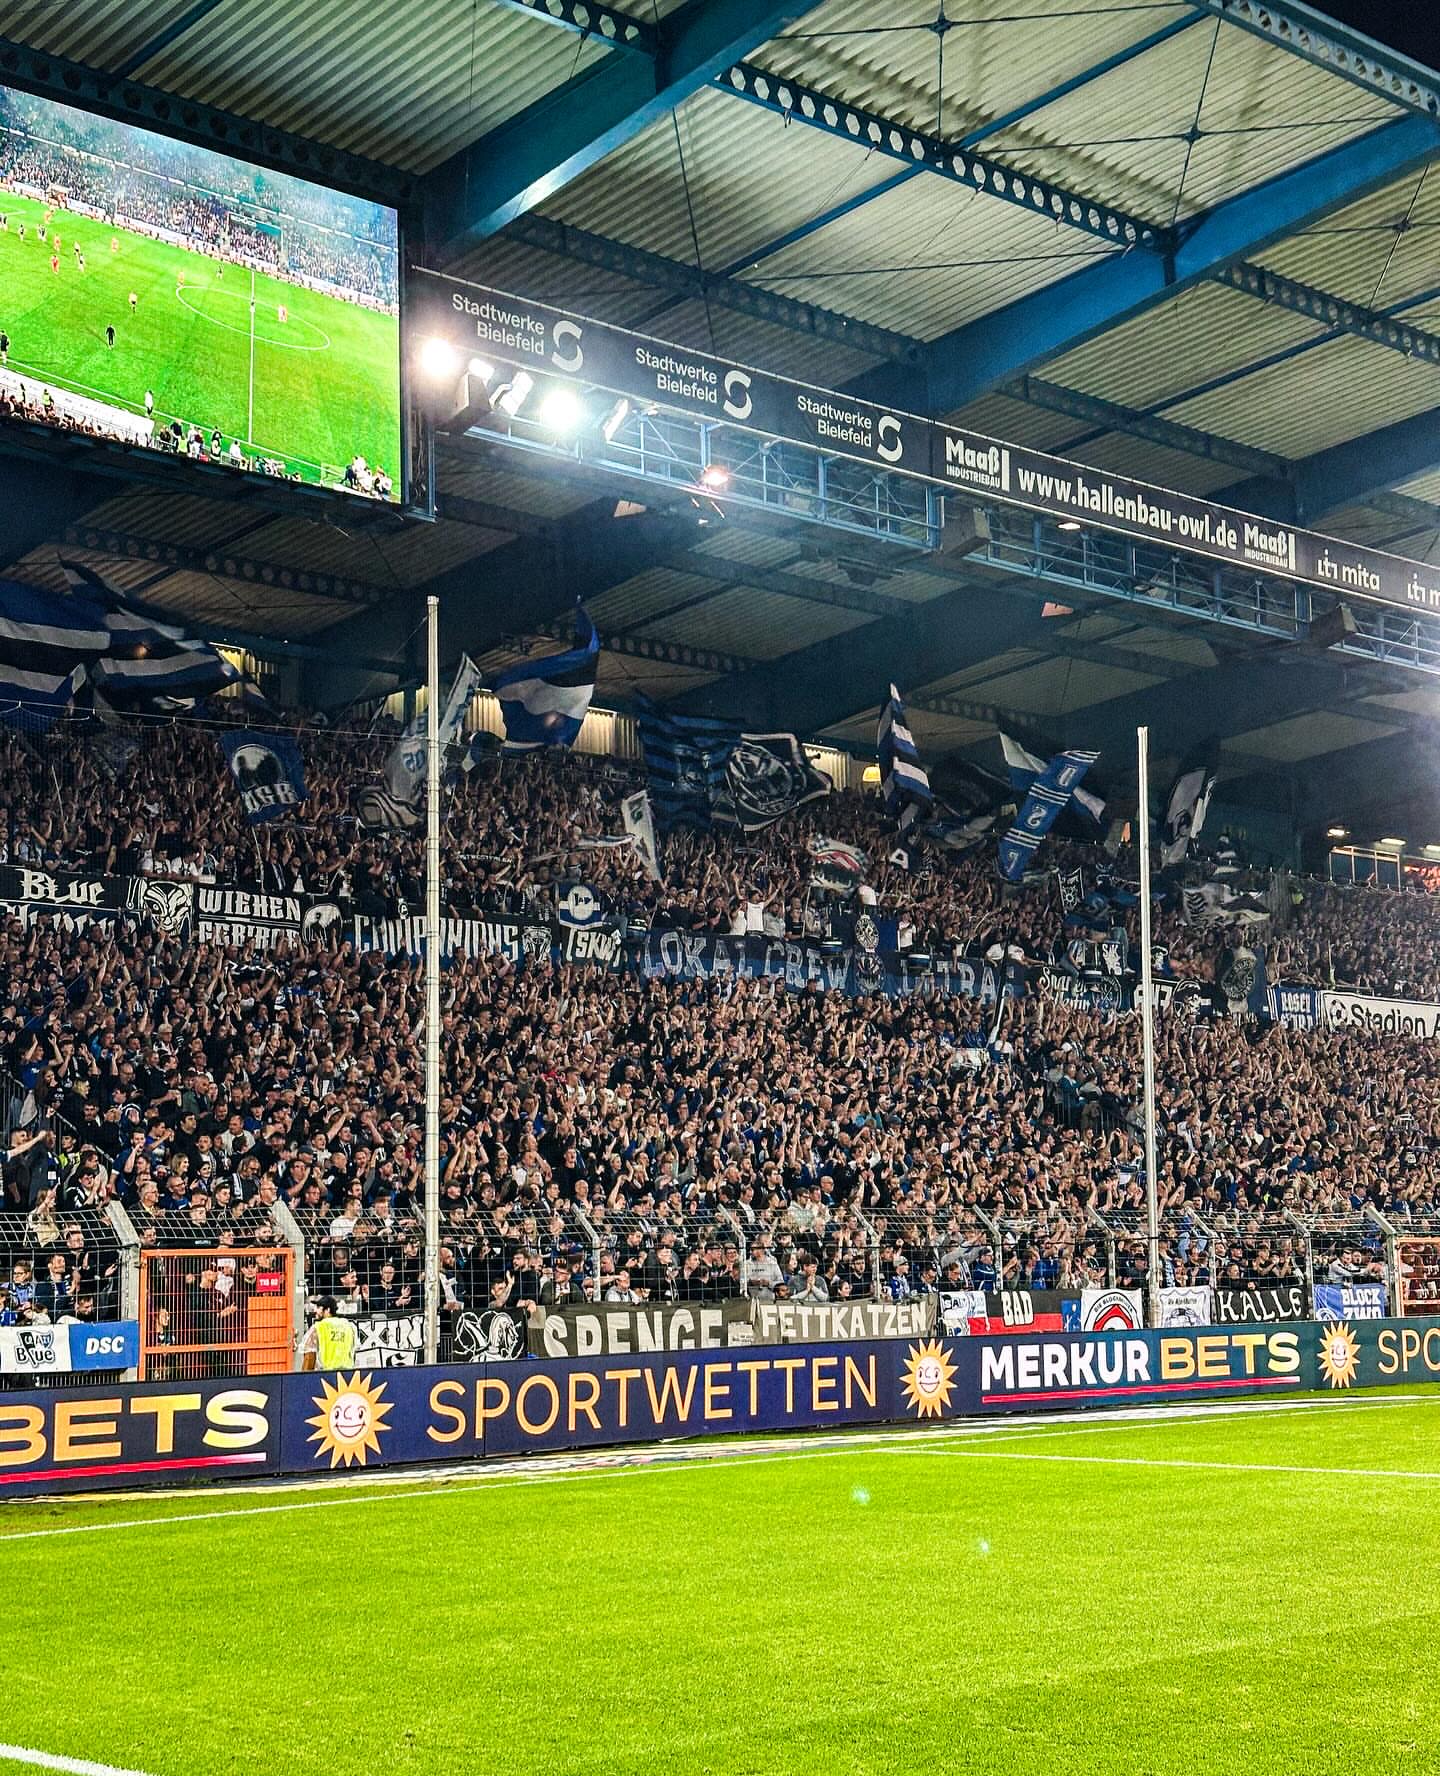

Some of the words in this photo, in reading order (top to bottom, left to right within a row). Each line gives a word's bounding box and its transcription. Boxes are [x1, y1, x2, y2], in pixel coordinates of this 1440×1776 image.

[452, 293, 545, 335] Stadtwerke
[477, 320, 545, 355] Bielefeld
[635, 347, 717, 384] Stadtwerke
[657, 373, 717, 404] Bielefeld
[797, 395, 872, 429] Stadtwerke
[817, 418, 872, 447] Bielefeld
[945, 436, 1000, 475] Maaß
[946, 464, 1000, 488] INDUSTRIEBAU
[1018, 467, 1238, 550] www.hallenbau-owl.de
[1244, 523, 1288, 557] Maaß
[1244, 547, 1289, 568] INDUSTRIEBAU
[1342, 563, 1380, 591] mita
[199, 888, 300, 920] WIEHEN
[643, 931, 752, 981] LOKAL
[764, 940, 850, 991] CREW
[1350, 1003, 1425, 1037] Stadion
[1001, 1291, 1034, 1327] BAD
[1217, 1287, 1303, 1322] KALLE
[1341, 1288, 1382, 1305] BLOCK
[543, 1308, 723, 1359] SPENGE
[760, 1302, 927, 1338] FETTKATZEN
[85, 1335, 125, 1355] DSC
[981, 1340, 1152, 1391] MERKUR
[1160, 1332, 1300, 1380] BETS
[426, 1354, 878, 1443] SPORTWETTEN
[0, 1390, 269, 1466] BETS
